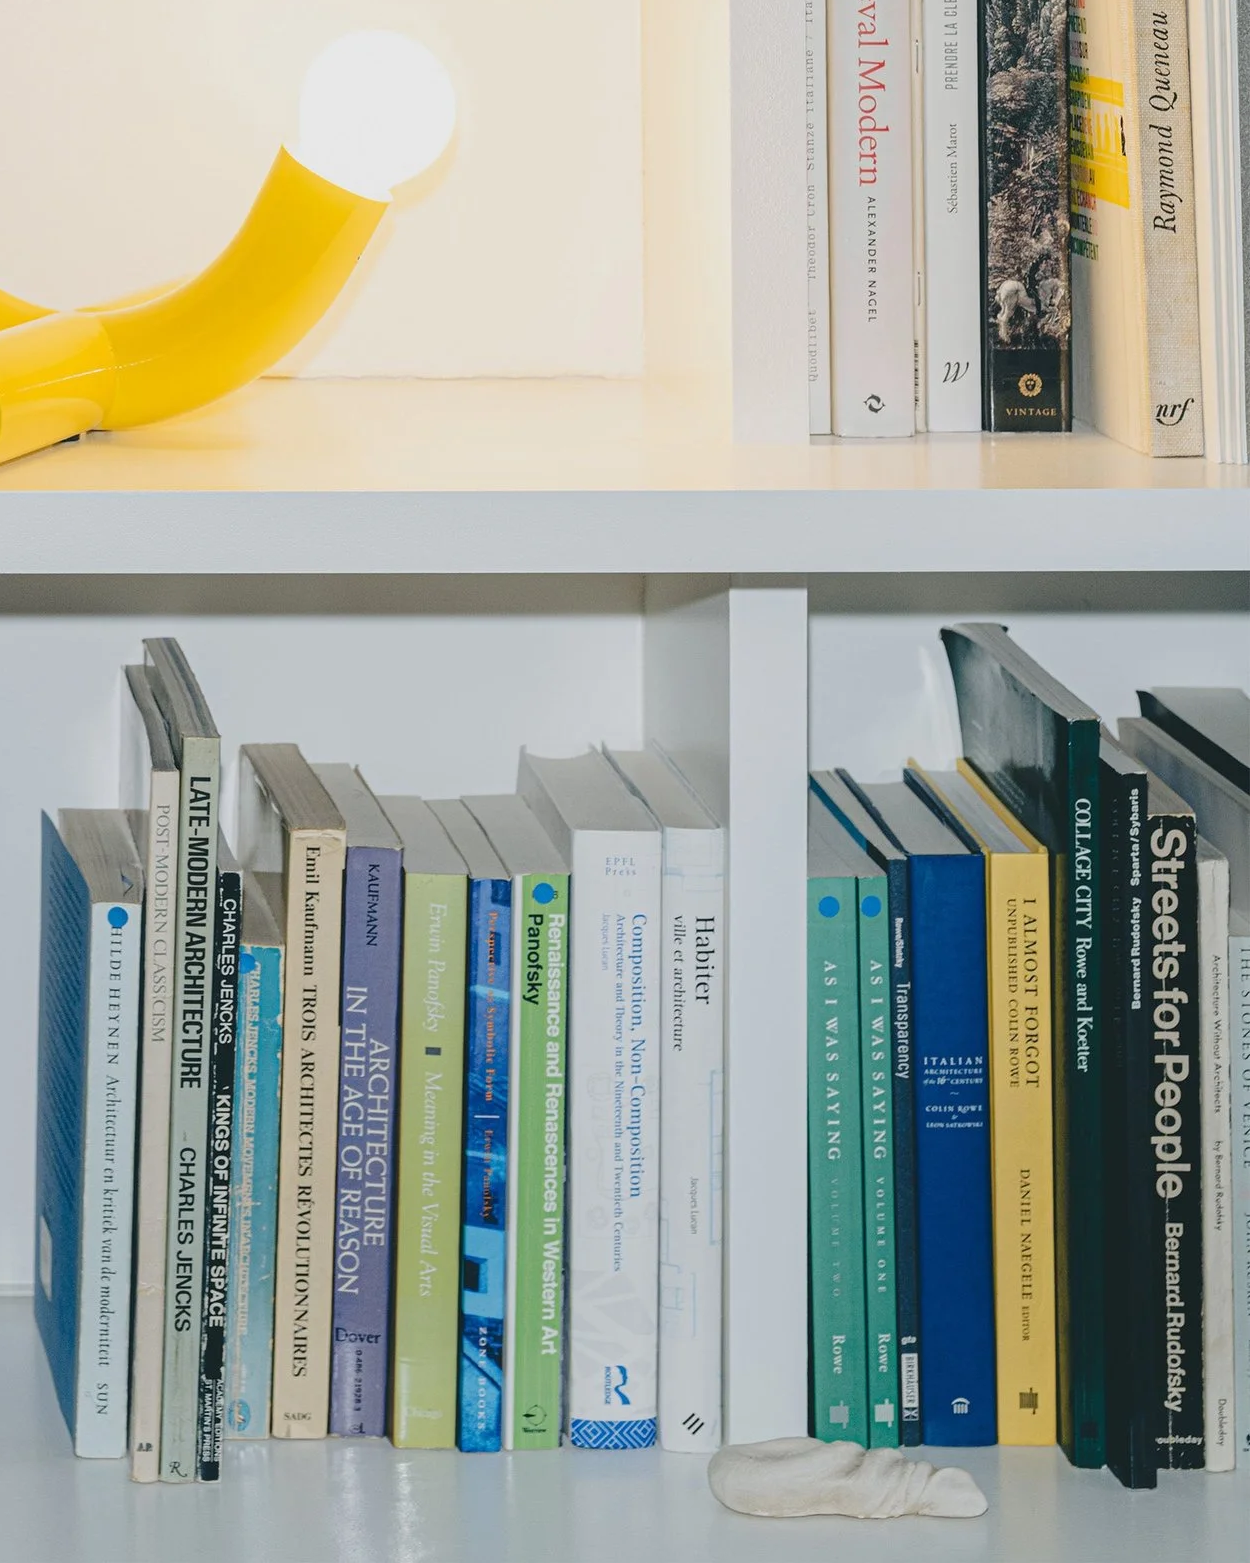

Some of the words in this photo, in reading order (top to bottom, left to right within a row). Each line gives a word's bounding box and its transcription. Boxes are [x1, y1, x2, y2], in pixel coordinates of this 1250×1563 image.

[1148, 10, 1178, 112] Queneau
[857, 58, 890, 187] Modern
[1149, 124, 1182, 234] Raymond
[867, 195, 877, 274] ALEXANDER
[868, 280, 877, 323] NAGEL
[1006, 408, 1057, 416] VINTAGE
[186, 777, 212, 926] LATE-MODERN
[1073, 797, 1091, 881] COLLAGE
[1129, 788, 1140, 887] Sparta/Sybaris
[366, 863, 380, 947] KAUFMANN
[1075, 886, 1092, 930] CITY
[1149, 827, 1188, 979] Streets
[521, 914, 544, 1006] Panofsky
[546, 914, 567, 1037] Renaissance
[695, 916, 716, 1005] Habiter
[1023, 913, 1039, 996] ALMOST
[180, 931, 206, 1089] ARCHITECTURE
[300, 985, 317, 1042] TROIS
[893, 982, 911, 1080] Transparency
[1024, 1006, 1041, 1088] FORGOT
[1152, 986, 1189, 1048] for
[545, 1042, 562, 1078] and
[923, 1056, 983, 1066] ITALIAN
[213, 1093, 232, 1153] KINGS
[297, 1048, 316, 1178] ARCHITECTES
[543, 1084, 563, 1214] Renascences
[825, 1072, 842, 1161] SAYING
[1150, 1054, 1192, 1199] People
[177, 1146, 196, 1245] CHARLES
[212, 1156, 229, 1182] OF
[210, 1186, 230, 1264] INFINITE
[1164, 1222, 1185, 1307] Bernard
[174, 1251, 194, 1333] JENCKS
[208, 1266, 227, 1328] SPACE
[292, 1185, 314, 1378] RÉVOLUTIONNAIRES
[1163, 1308, 1186, 1413] Rudofsky
